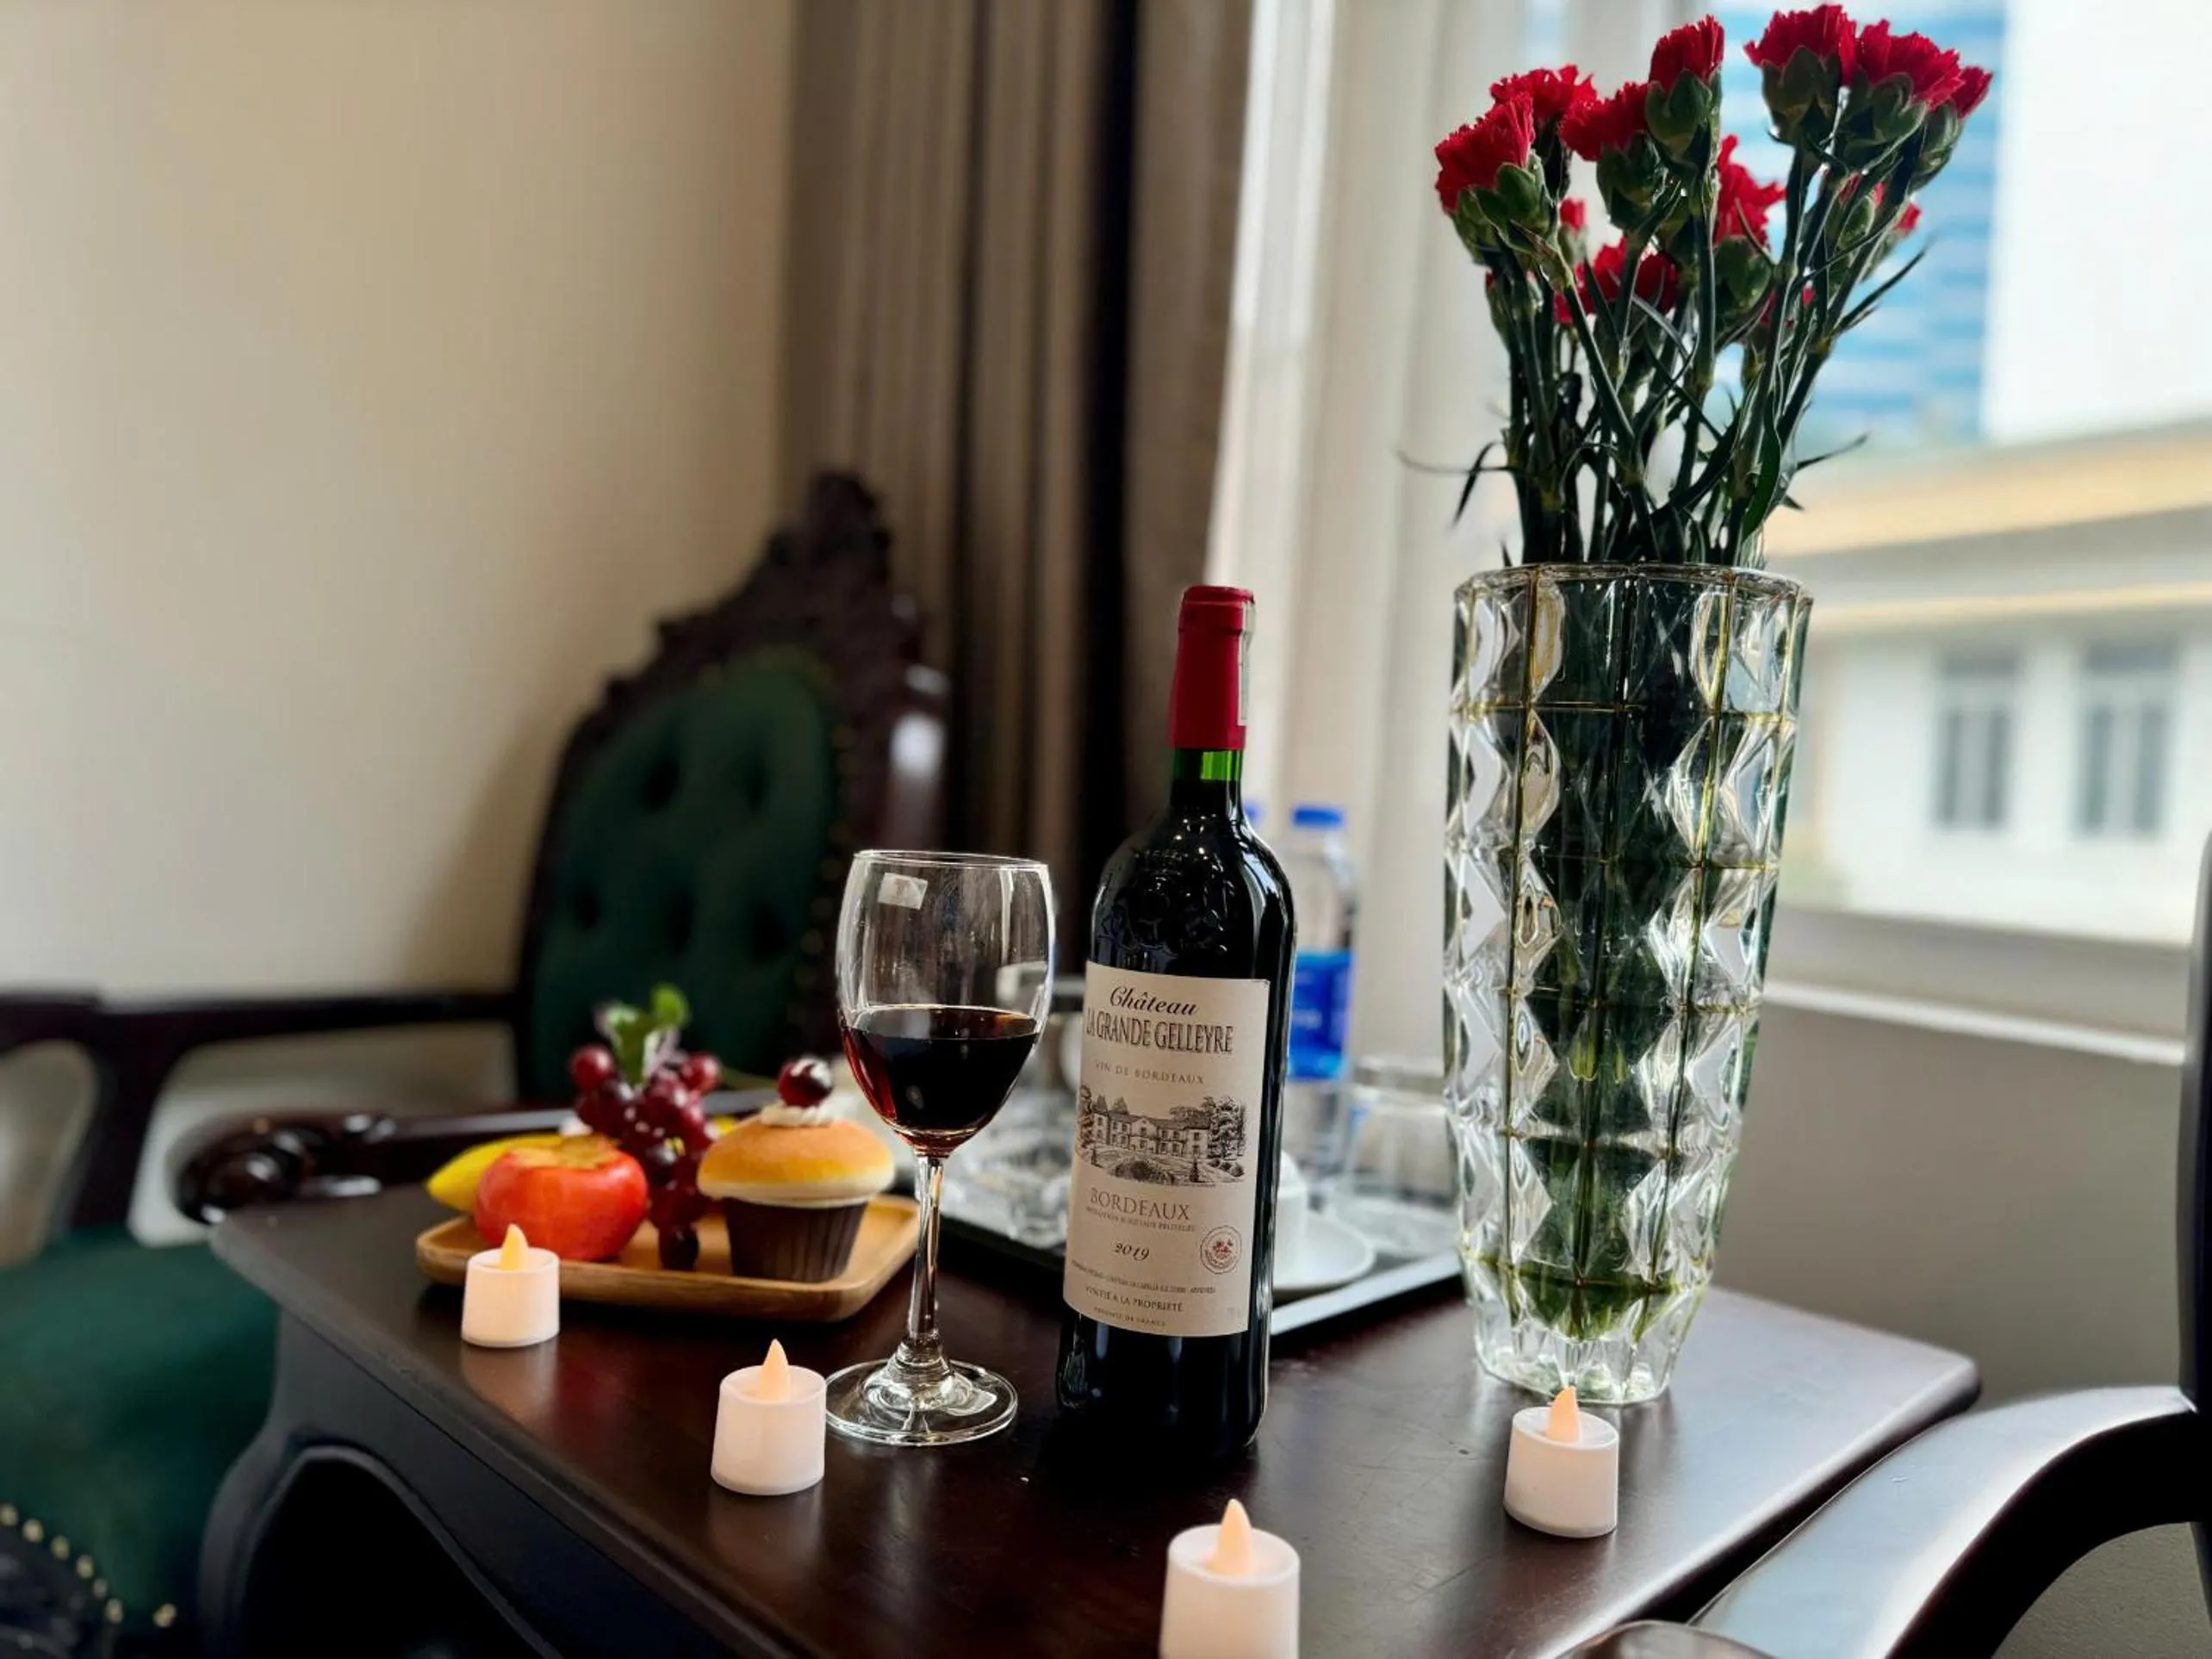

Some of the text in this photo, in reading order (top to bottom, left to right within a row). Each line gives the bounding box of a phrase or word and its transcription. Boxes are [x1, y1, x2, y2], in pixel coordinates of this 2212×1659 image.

[1109, 985, 1198, 1016] Château
[1097, 1010, 1151, 1048] GRANDE
[1096, 1059, 1204, 1084] VIN DE BORDEAUX
[1090, 1187, 1190, 1221] BORDEAUX
[1114, 1242, 1151, 1262] 2019
